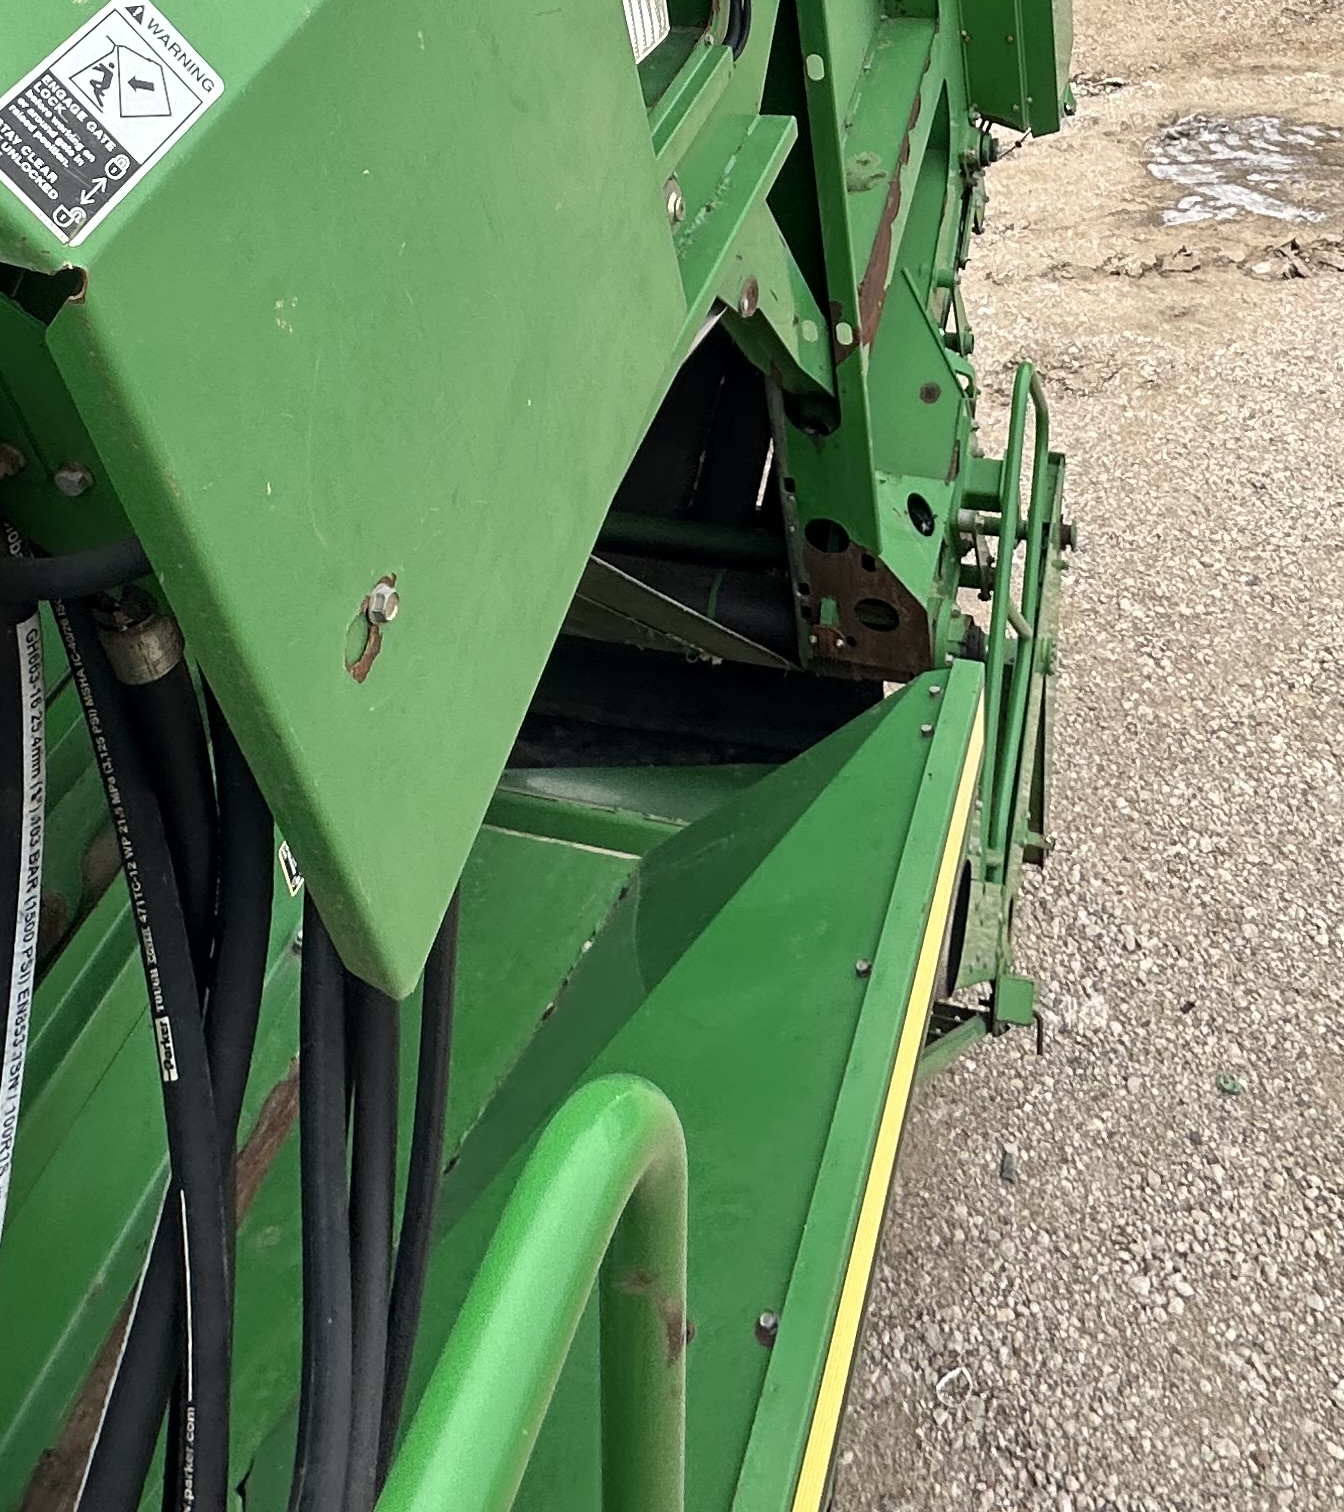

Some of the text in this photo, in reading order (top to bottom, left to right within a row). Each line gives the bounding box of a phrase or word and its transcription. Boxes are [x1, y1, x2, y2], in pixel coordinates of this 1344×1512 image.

[147, 17, 215, 94] WARNING
[8, 104, 37, 133] raised
[33, 81, 67, 116] LOCK
[41, 74, 117, 152] ENGAGE GATE
[17, 98, 85, 167] or around gate in
[25, 89, 96, 163] before working on
[1, 141, 58, 200] UNLOCKED
[21, 145, 58, 183] CLEAR
[25, 628, 43, 709] GH663-16
[74, 668, 95, 707] MSHA
[26, 849, 40, 893] BAR
[121, 836, 134, 859] WP
[127, 861, 147, 923] 471TC-12
[22, 895, 37, 943] (1500
[17, 945, 33, 985] PSI)
[160, 1020, 174, 1071] Parker
